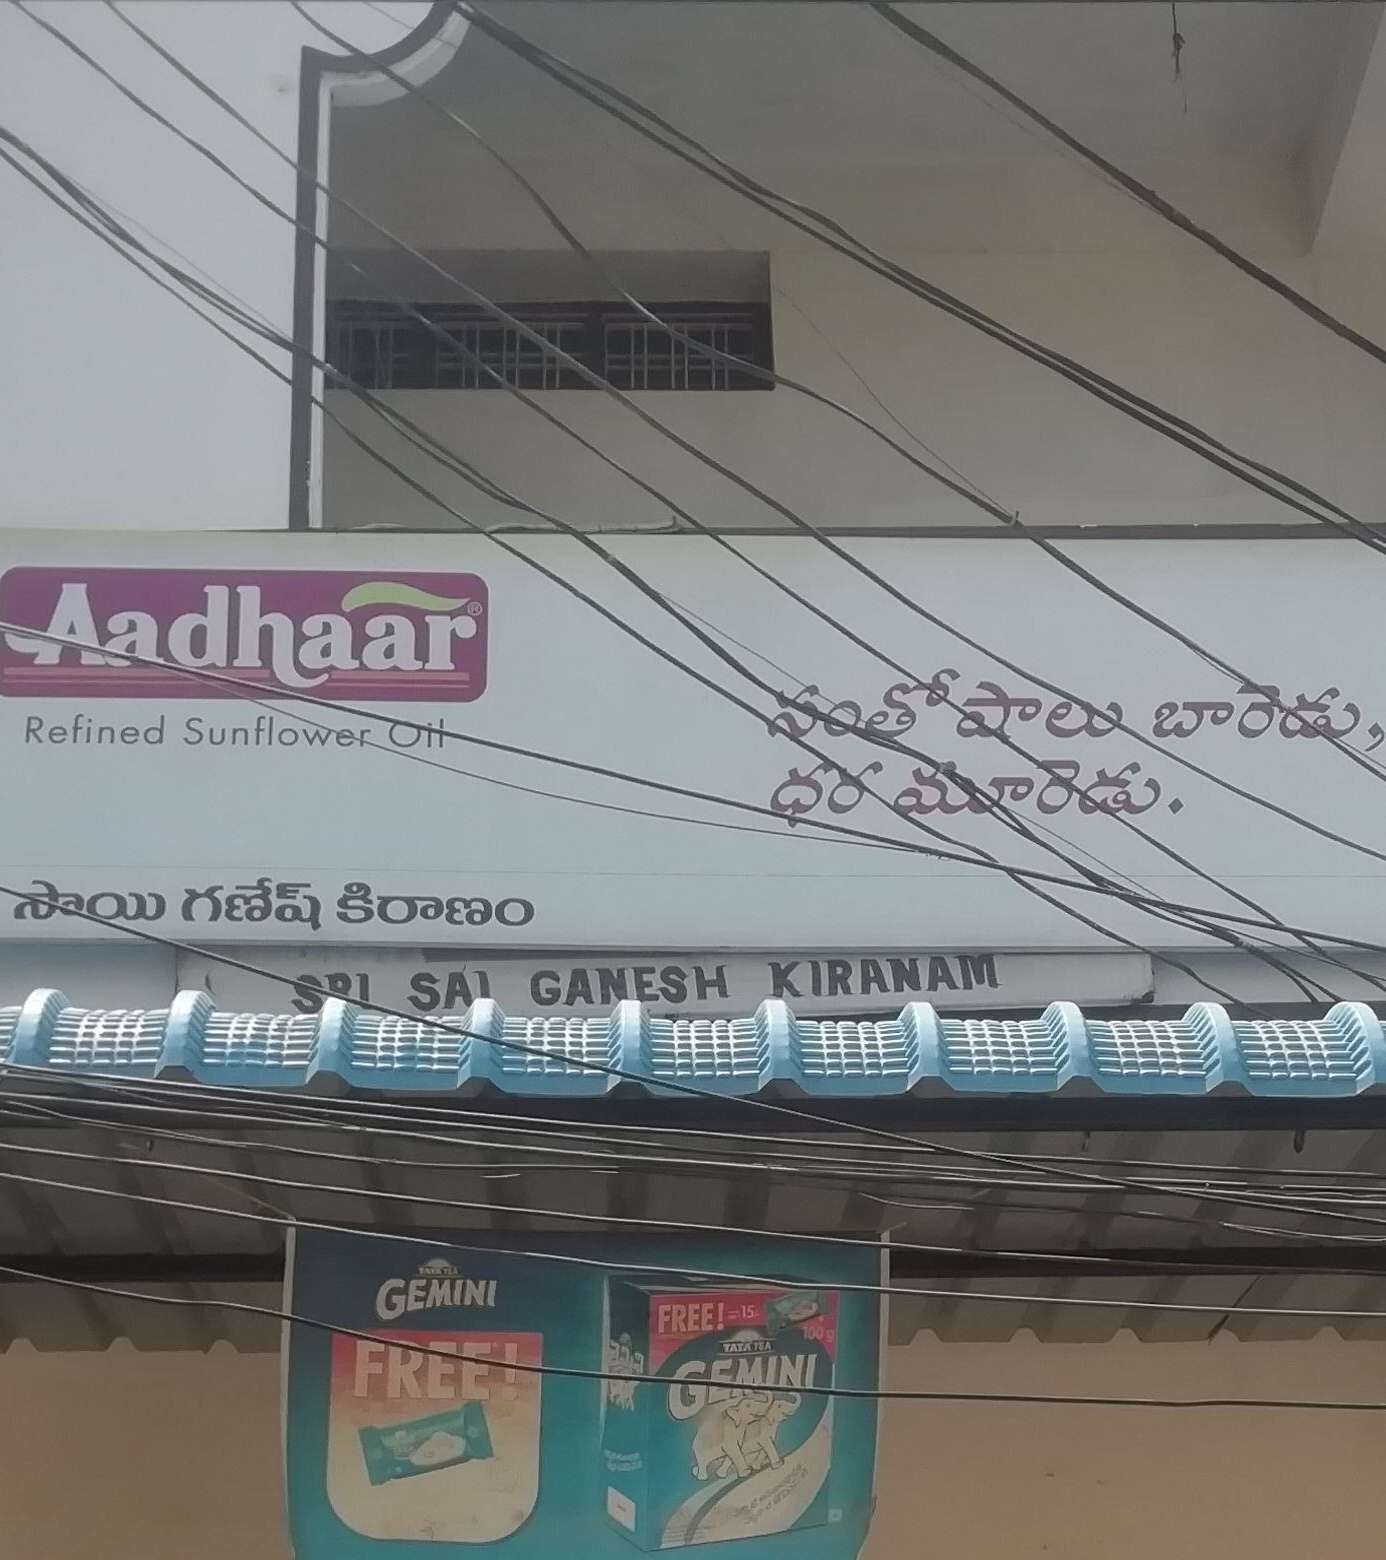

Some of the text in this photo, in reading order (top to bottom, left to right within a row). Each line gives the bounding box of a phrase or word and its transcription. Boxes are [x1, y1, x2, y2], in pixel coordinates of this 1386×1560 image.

[3, 582, 479, 687] Aadhaar
[24, 715, 446, 750] Refined Sunflower Oil
[13, 879, 168, 923] సాయి
[181, 877, 323, 931] గణేష్
[294, 954, 1002, 1014] SRI SAI GANESH KIRANAM
[375, 1276, 497, 1320] GEMINI
[657, 1302, 725, 1334] FREE!
[667, 1353, 818, 1421] GEMINI
